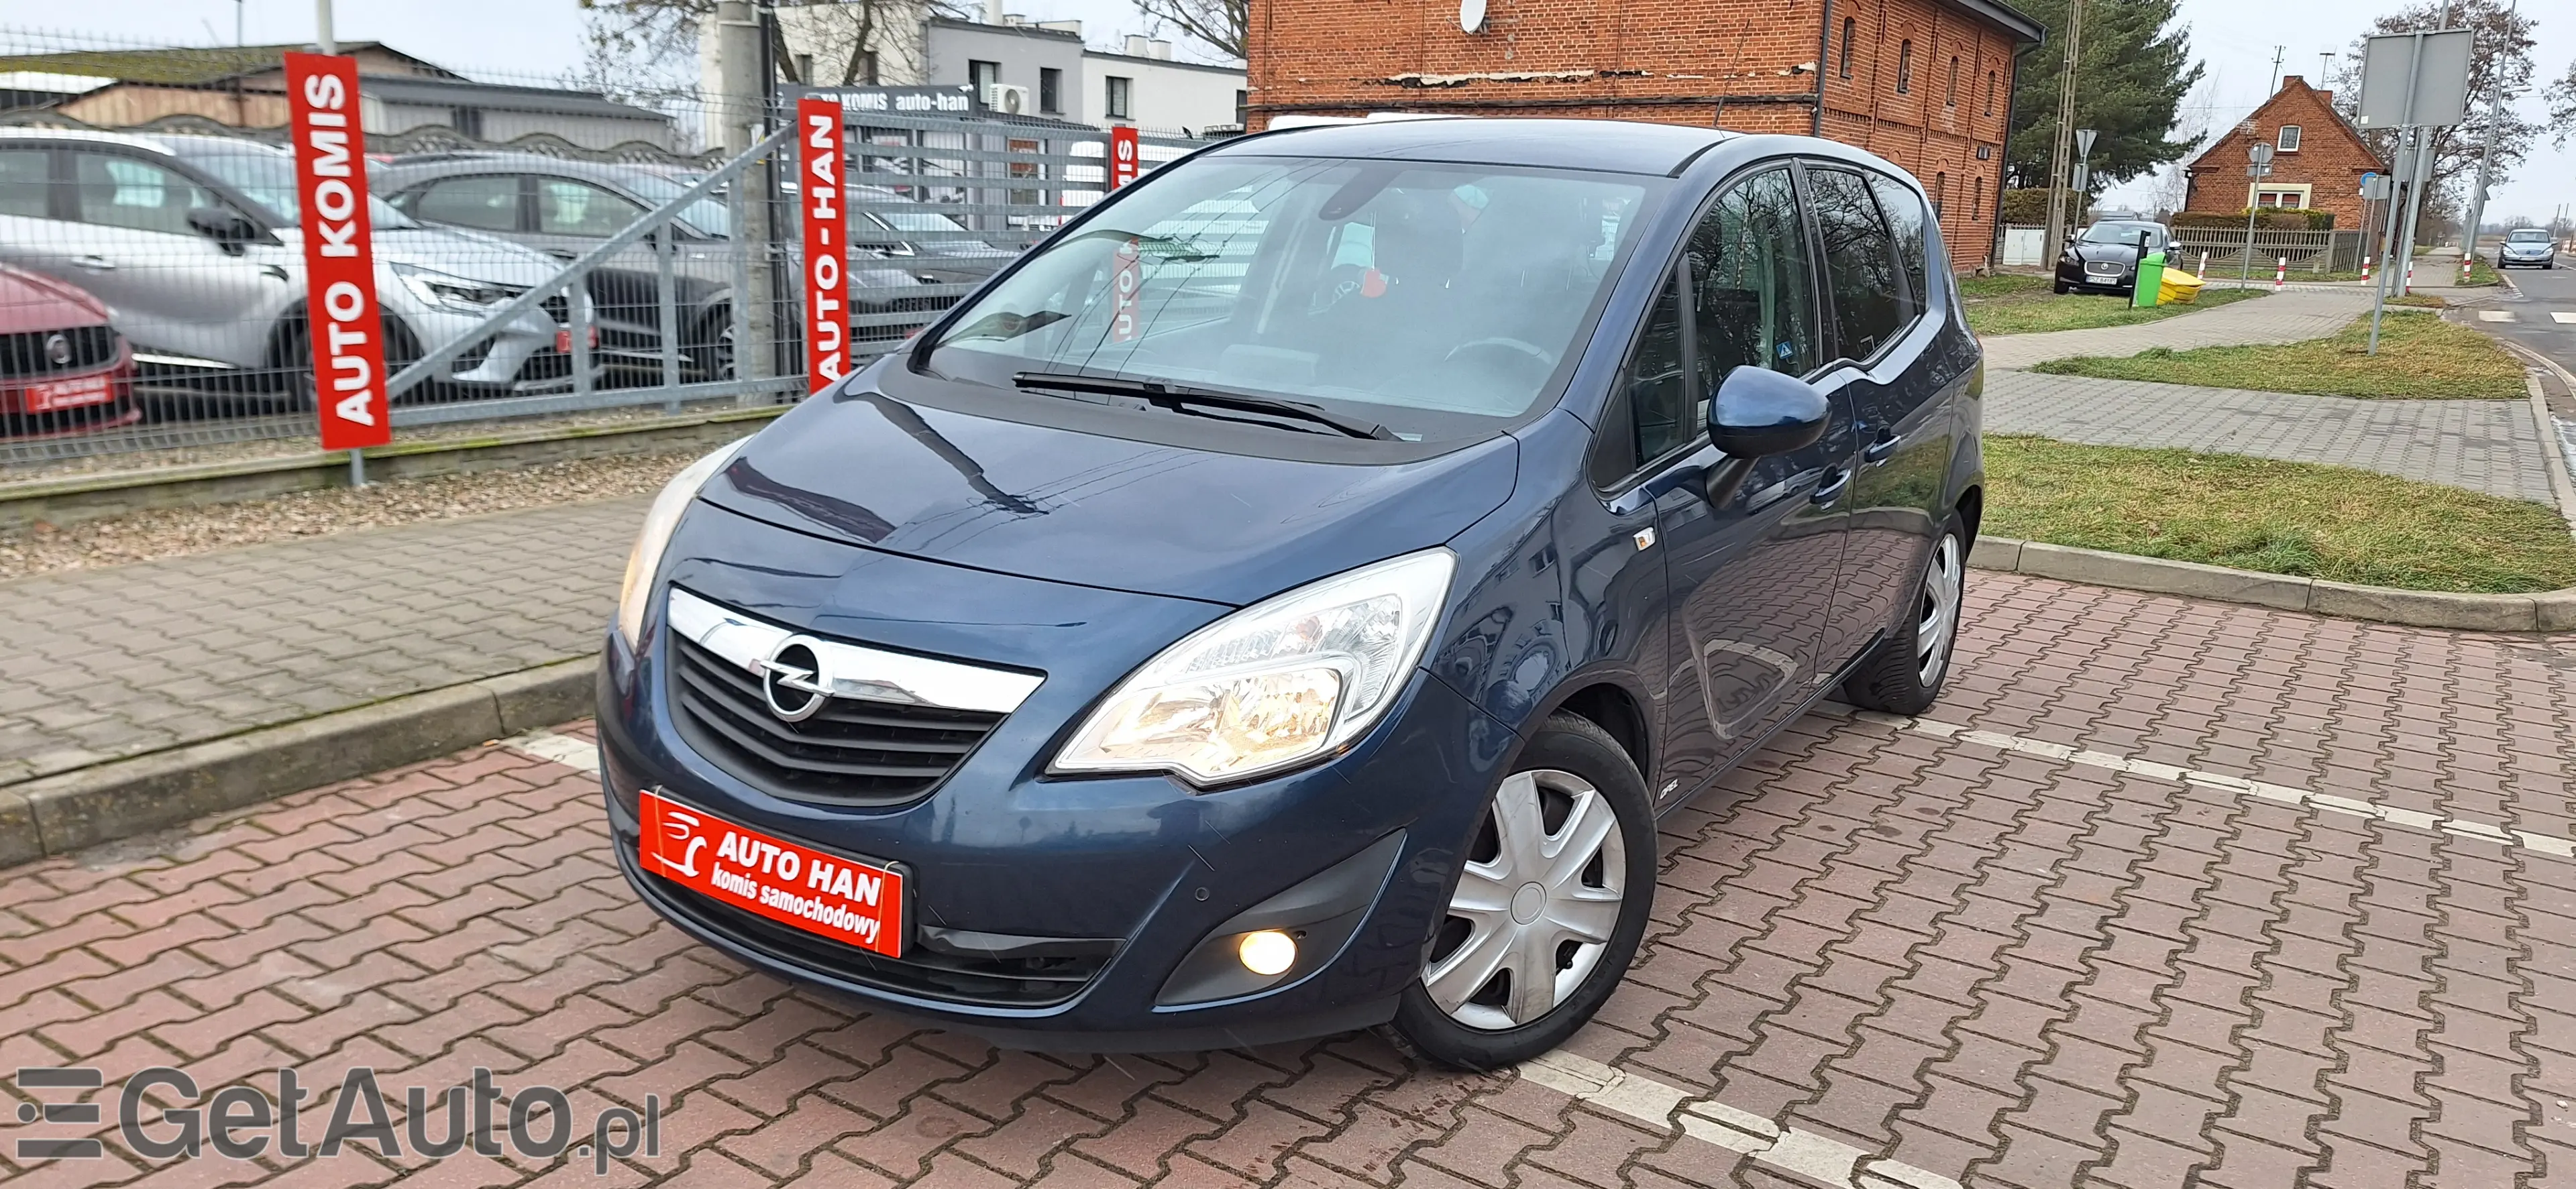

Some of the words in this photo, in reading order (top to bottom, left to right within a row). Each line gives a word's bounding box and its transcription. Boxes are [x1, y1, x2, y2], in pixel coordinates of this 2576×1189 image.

[895, 93, 969, 111] auto-han
[305, 74, 359, 258] KOMIS
[1118, 270, 1133, 340] UTO
[324, 281, 374, 427] AUTO
[711, 861, 757, 900] komis
[759, 883, 881, 944] samochodowy
[716, 830, 800, 881] AUTO
[807, 859, 881, 907] HAN
